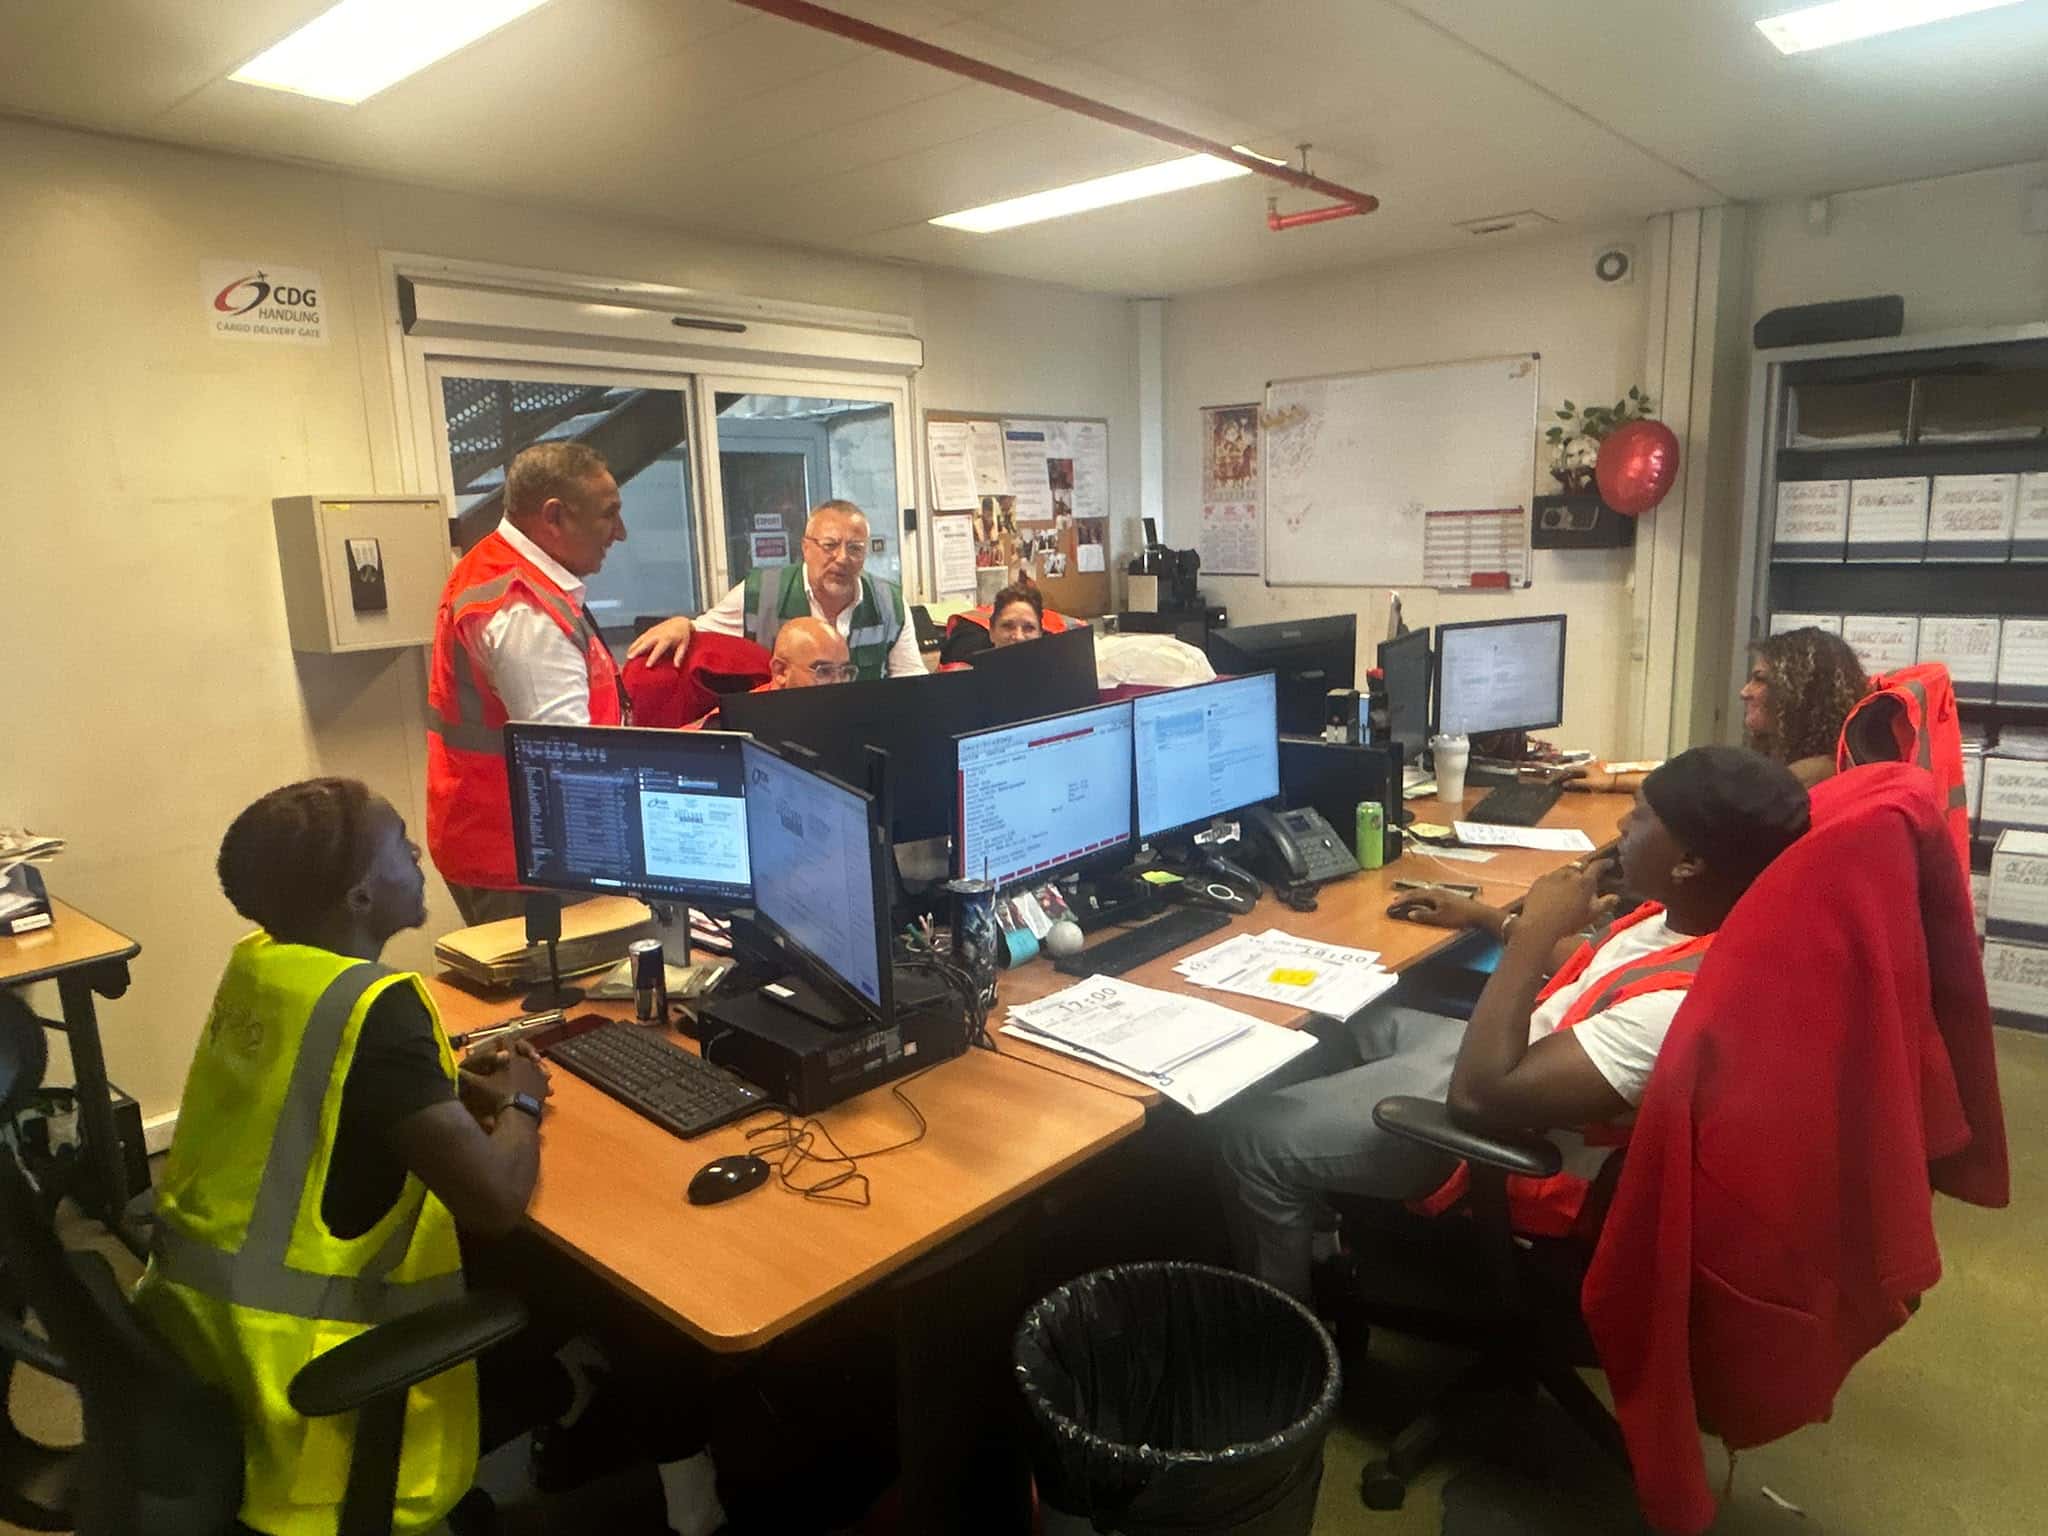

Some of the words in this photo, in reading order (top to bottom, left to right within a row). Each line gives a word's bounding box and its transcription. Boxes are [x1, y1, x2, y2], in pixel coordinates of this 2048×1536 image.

[273, 286, 317, 307] CDG
[258, 307, 320, 324] HANDLING
[216, 320, 250, 332] CARGO
[253, 325, 296, 336] DELIVERY
[297, 327, 321, 339] GATE
